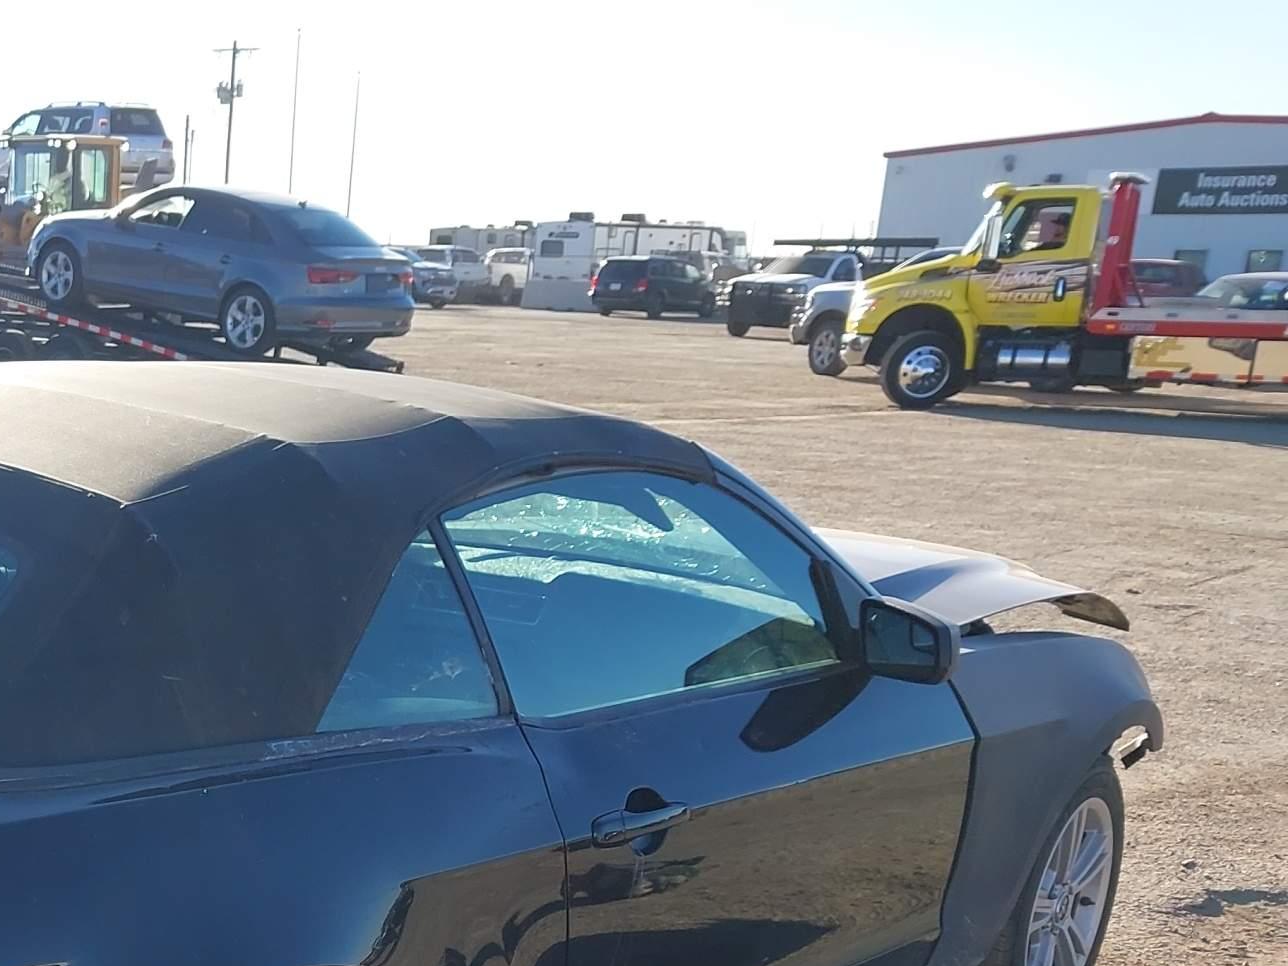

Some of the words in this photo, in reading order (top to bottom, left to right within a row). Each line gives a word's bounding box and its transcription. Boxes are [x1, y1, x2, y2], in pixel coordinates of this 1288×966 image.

[1197, 172, 1277, 188] Insurance
[1177, 191, 1215, 208] Auto
[1217, 190, 1288, 208] Auctions
[985, 292, 1050, 304] WRECKER
